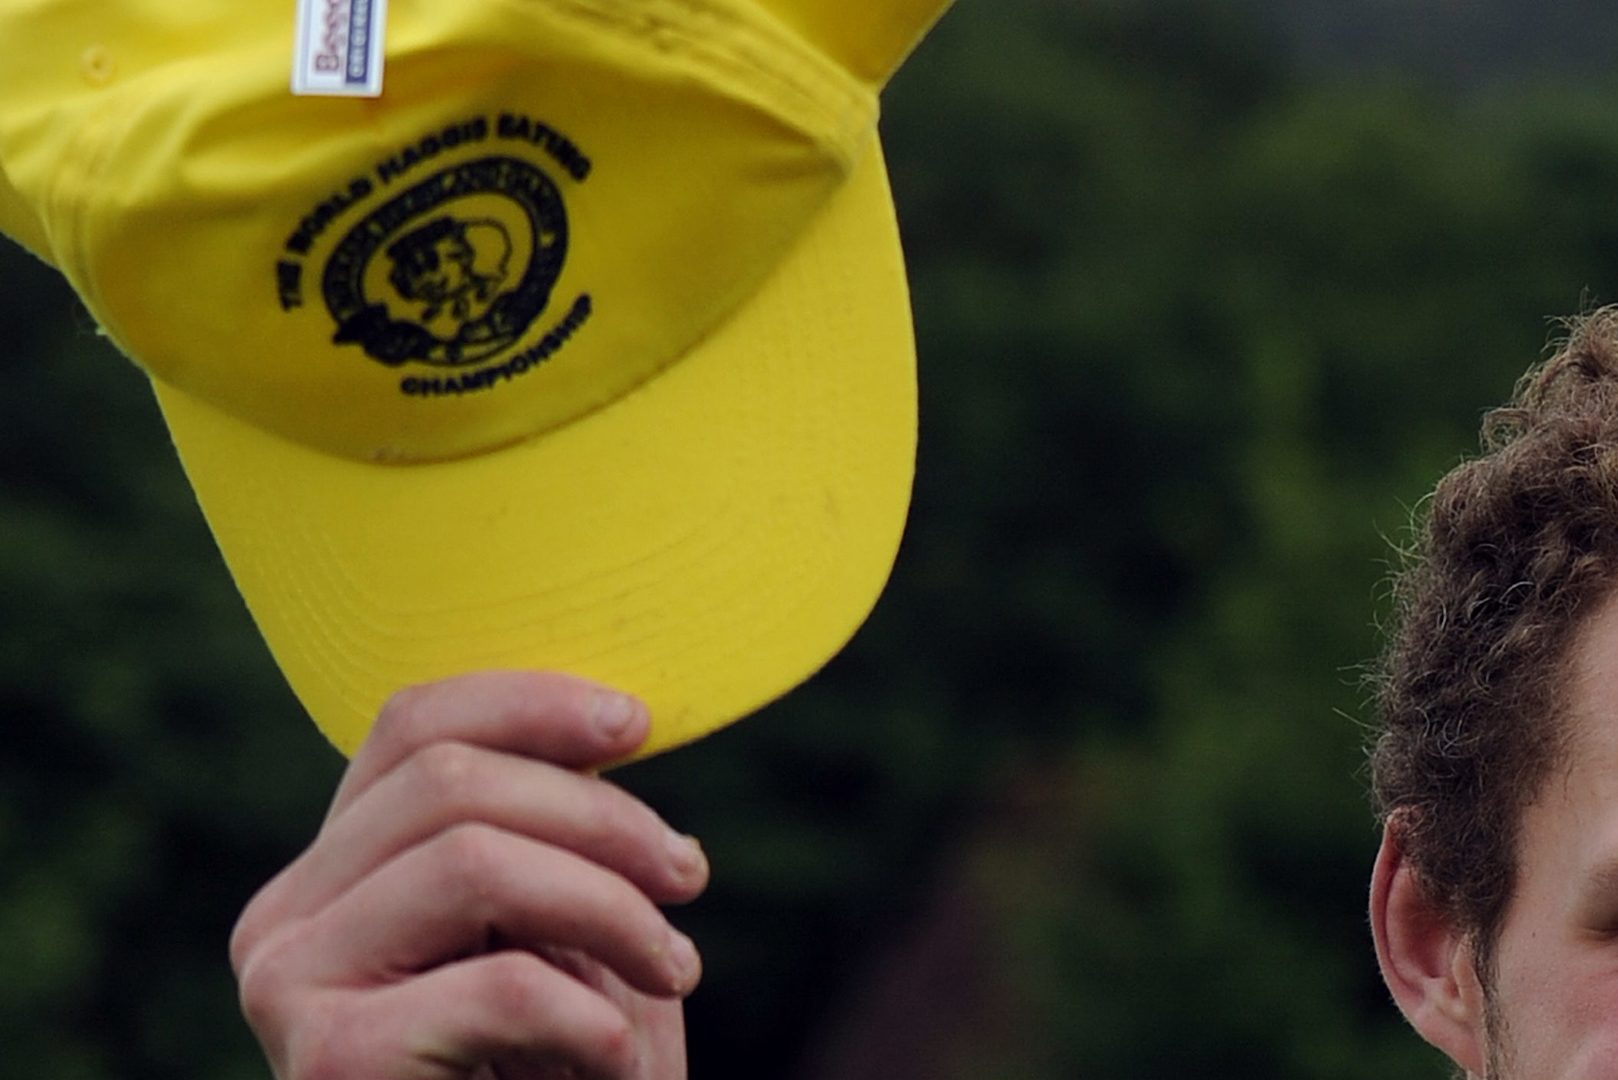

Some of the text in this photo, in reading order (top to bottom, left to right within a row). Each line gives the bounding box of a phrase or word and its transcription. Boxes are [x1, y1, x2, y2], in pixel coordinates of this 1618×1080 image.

[276, 113, 592, 311] THE WORLD HAGGIS EATING
[400, 293, 592, 397] CHAMPIONSHIP
